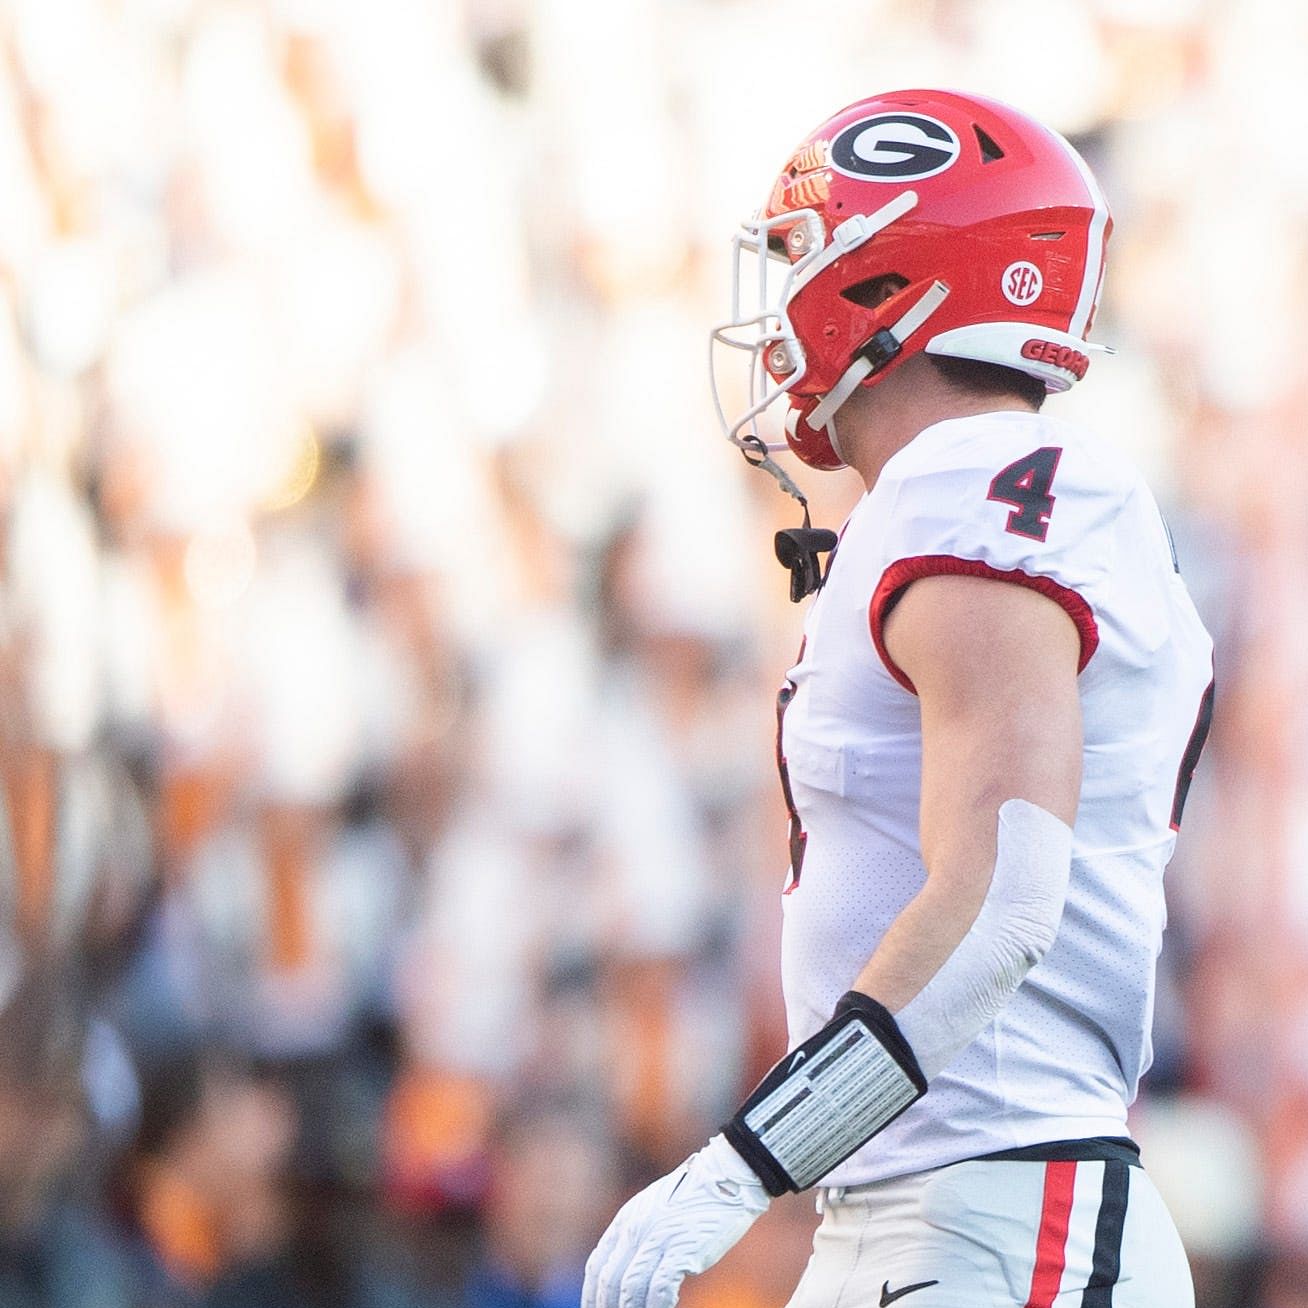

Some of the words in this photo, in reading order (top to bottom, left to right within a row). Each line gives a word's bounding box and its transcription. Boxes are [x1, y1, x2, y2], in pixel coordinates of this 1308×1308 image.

[831, 115, 955, 178] G
[1007, 267, 1039, 300] SEC
[986, 446, 1063, 543] 4
